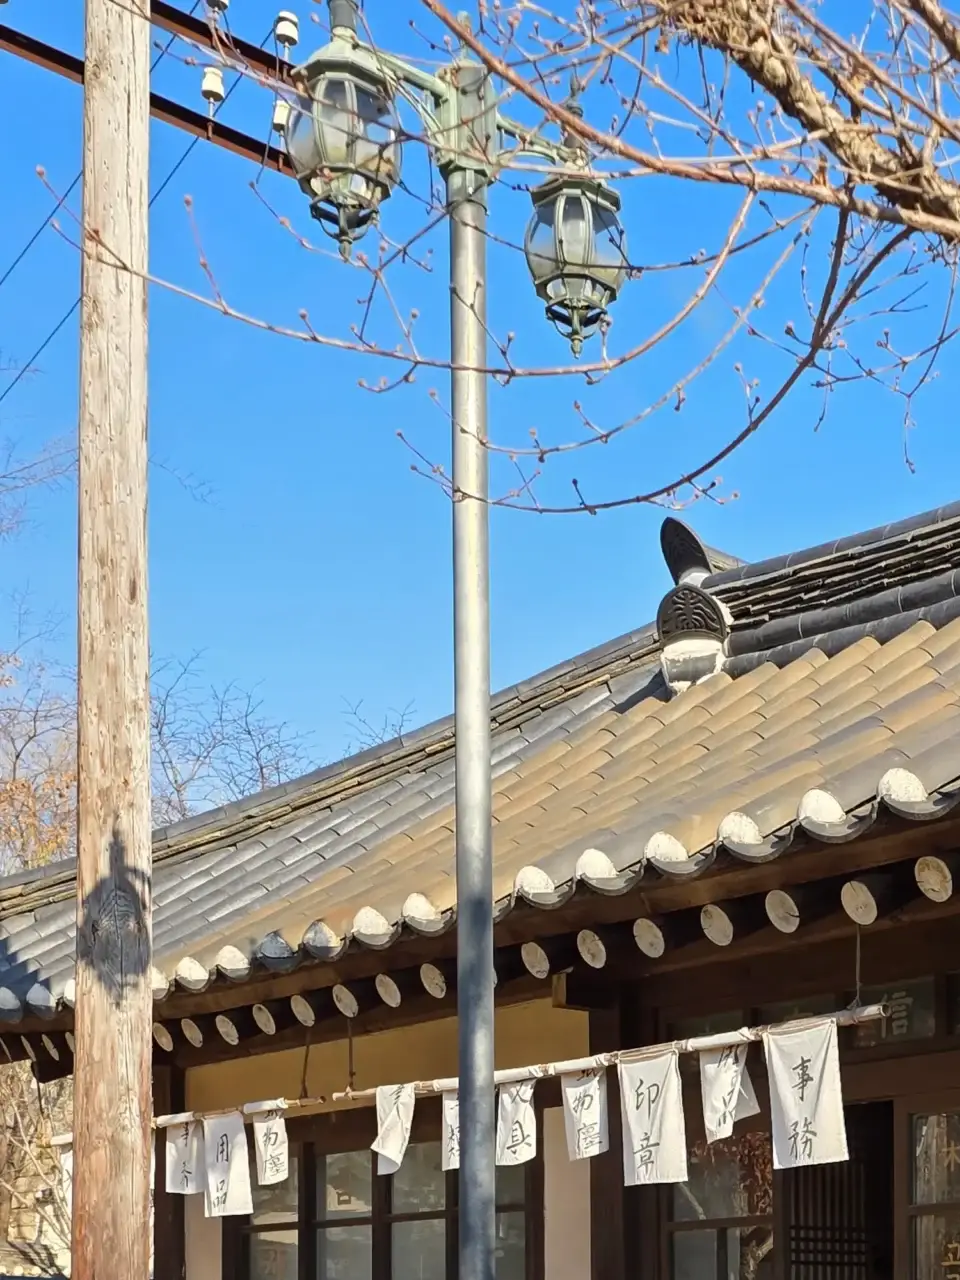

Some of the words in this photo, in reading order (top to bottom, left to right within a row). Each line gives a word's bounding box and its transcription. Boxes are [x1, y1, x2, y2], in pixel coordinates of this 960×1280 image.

[633, 1078, 660, 1174] 印章
[788, 1056, 818, 1160] 事務
[212, 1133, 230, 1209] 用品
